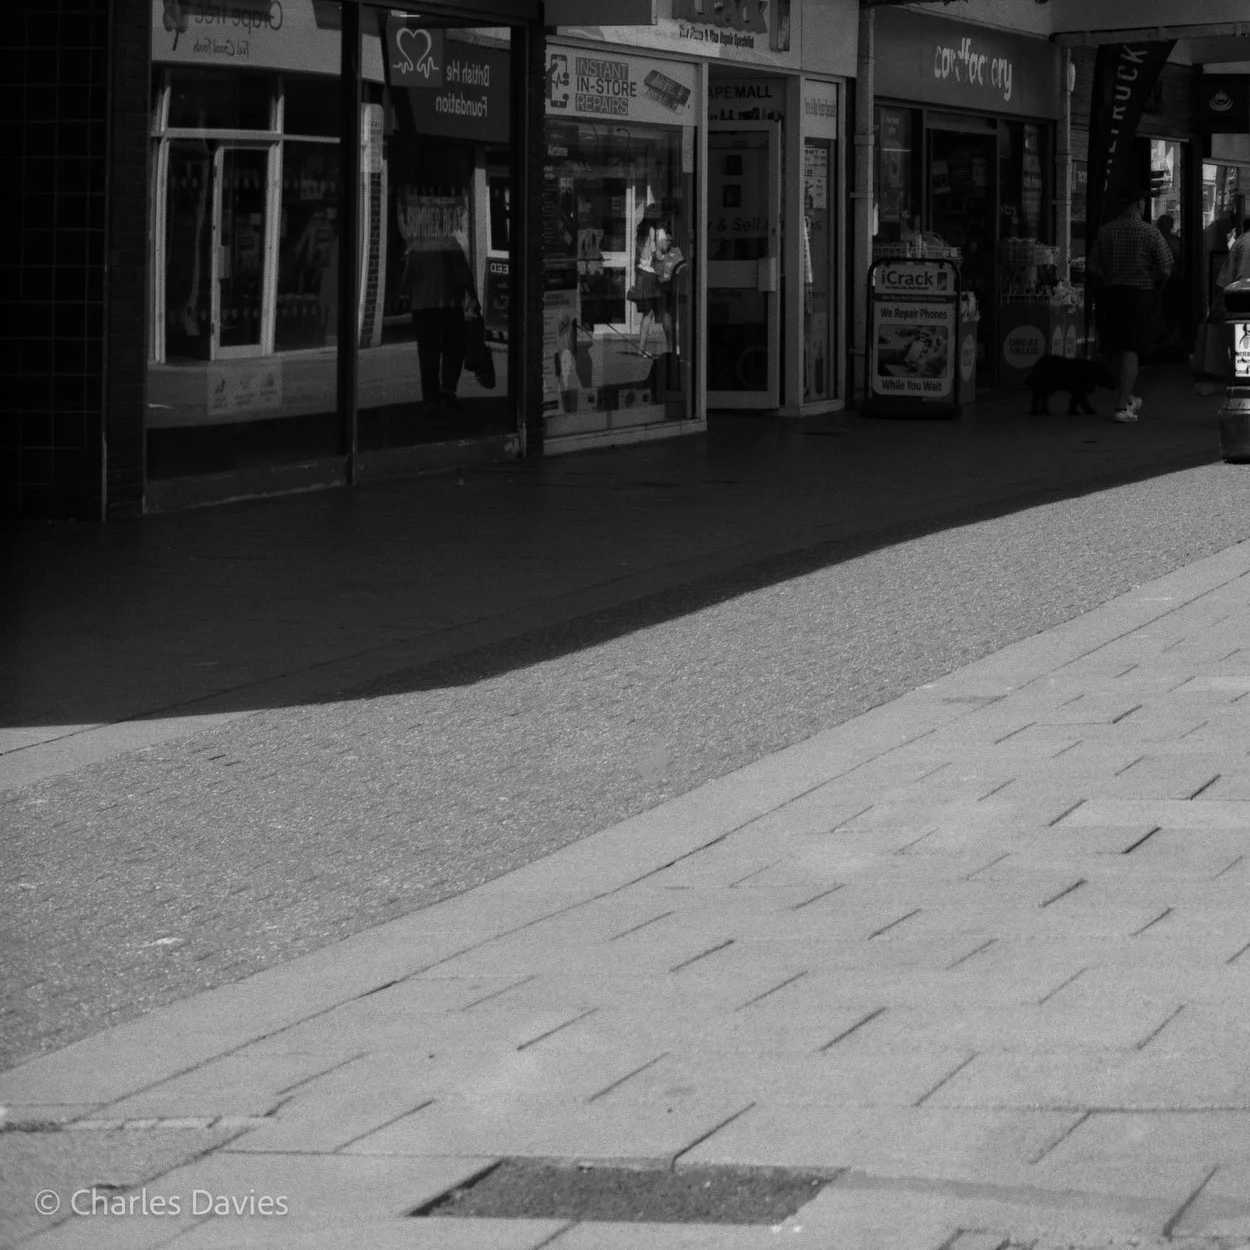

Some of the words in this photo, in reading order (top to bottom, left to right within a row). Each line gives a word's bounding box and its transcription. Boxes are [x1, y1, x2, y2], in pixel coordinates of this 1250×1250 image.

[576, 58, 629, 80] INSTANT
[577, 76, 637, 97] IN-STORE
[708, 85, 773, 99] APEMALL
[576, 95, 629, 116] REPAIRS
[881, 270, 933, 287] iCrack
[880, 307, 893, 318] We
[894, 308, 918, 320] Repair
[920, 308, 947, 320] Phones
[882, 379, 905, 391] While
[907, 380, 921, 391] You
[923, 380, 942, 392] Wait
